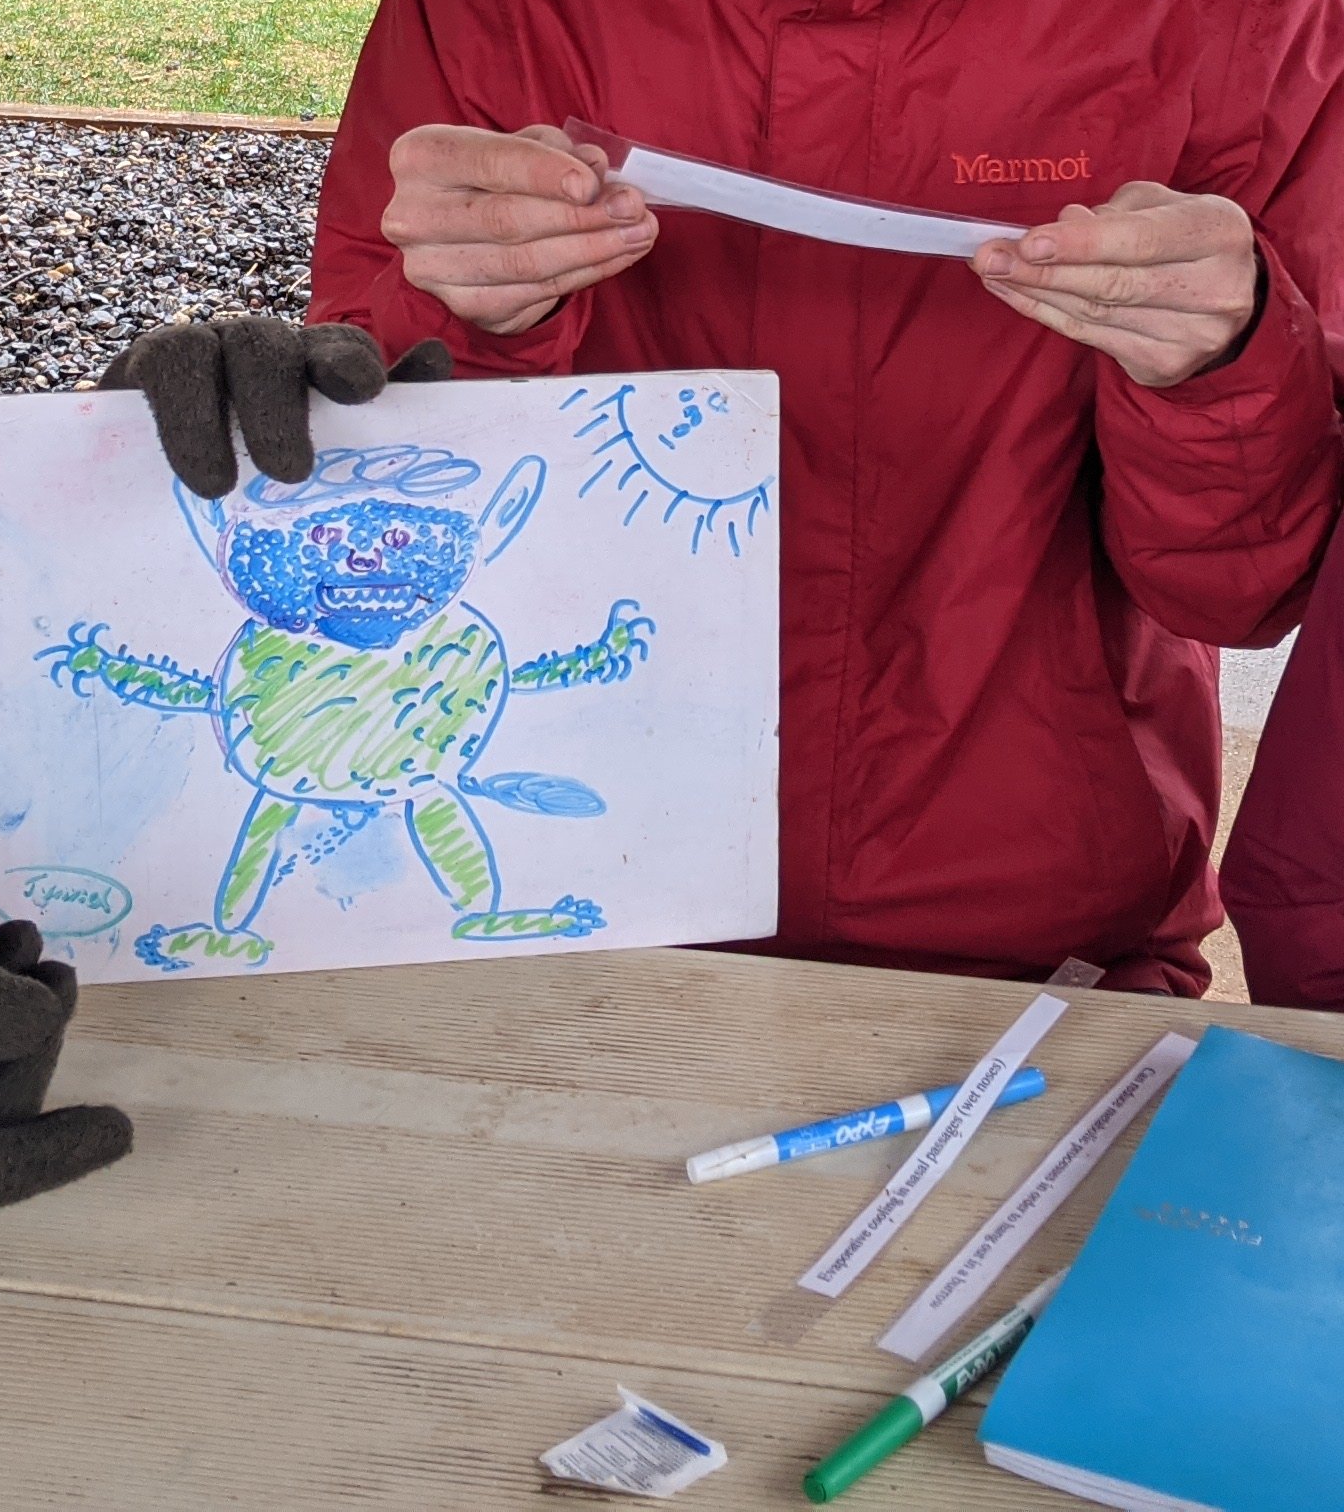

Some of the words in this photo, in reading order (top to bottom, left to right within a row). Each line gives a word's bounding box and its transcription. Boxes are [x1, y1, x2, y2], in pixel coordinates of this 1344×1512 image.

[951, 149, 1092, 185] Marmot
[836, 1110, 890, 1145] EXPO
[817, 1230, 872, 1283] Evaporative
[868, 1196, 904, 1231] cooling
[892, 1187, 910, 1198] in
[905, 1158, 930, 1188] nasal
[926, 1114, 964, 1165] passages
[956, 1089, 981, 1117] (wet
[976, 1057, 1007, 1093] noses)
[929, 1276, 967, 1309] burrow
